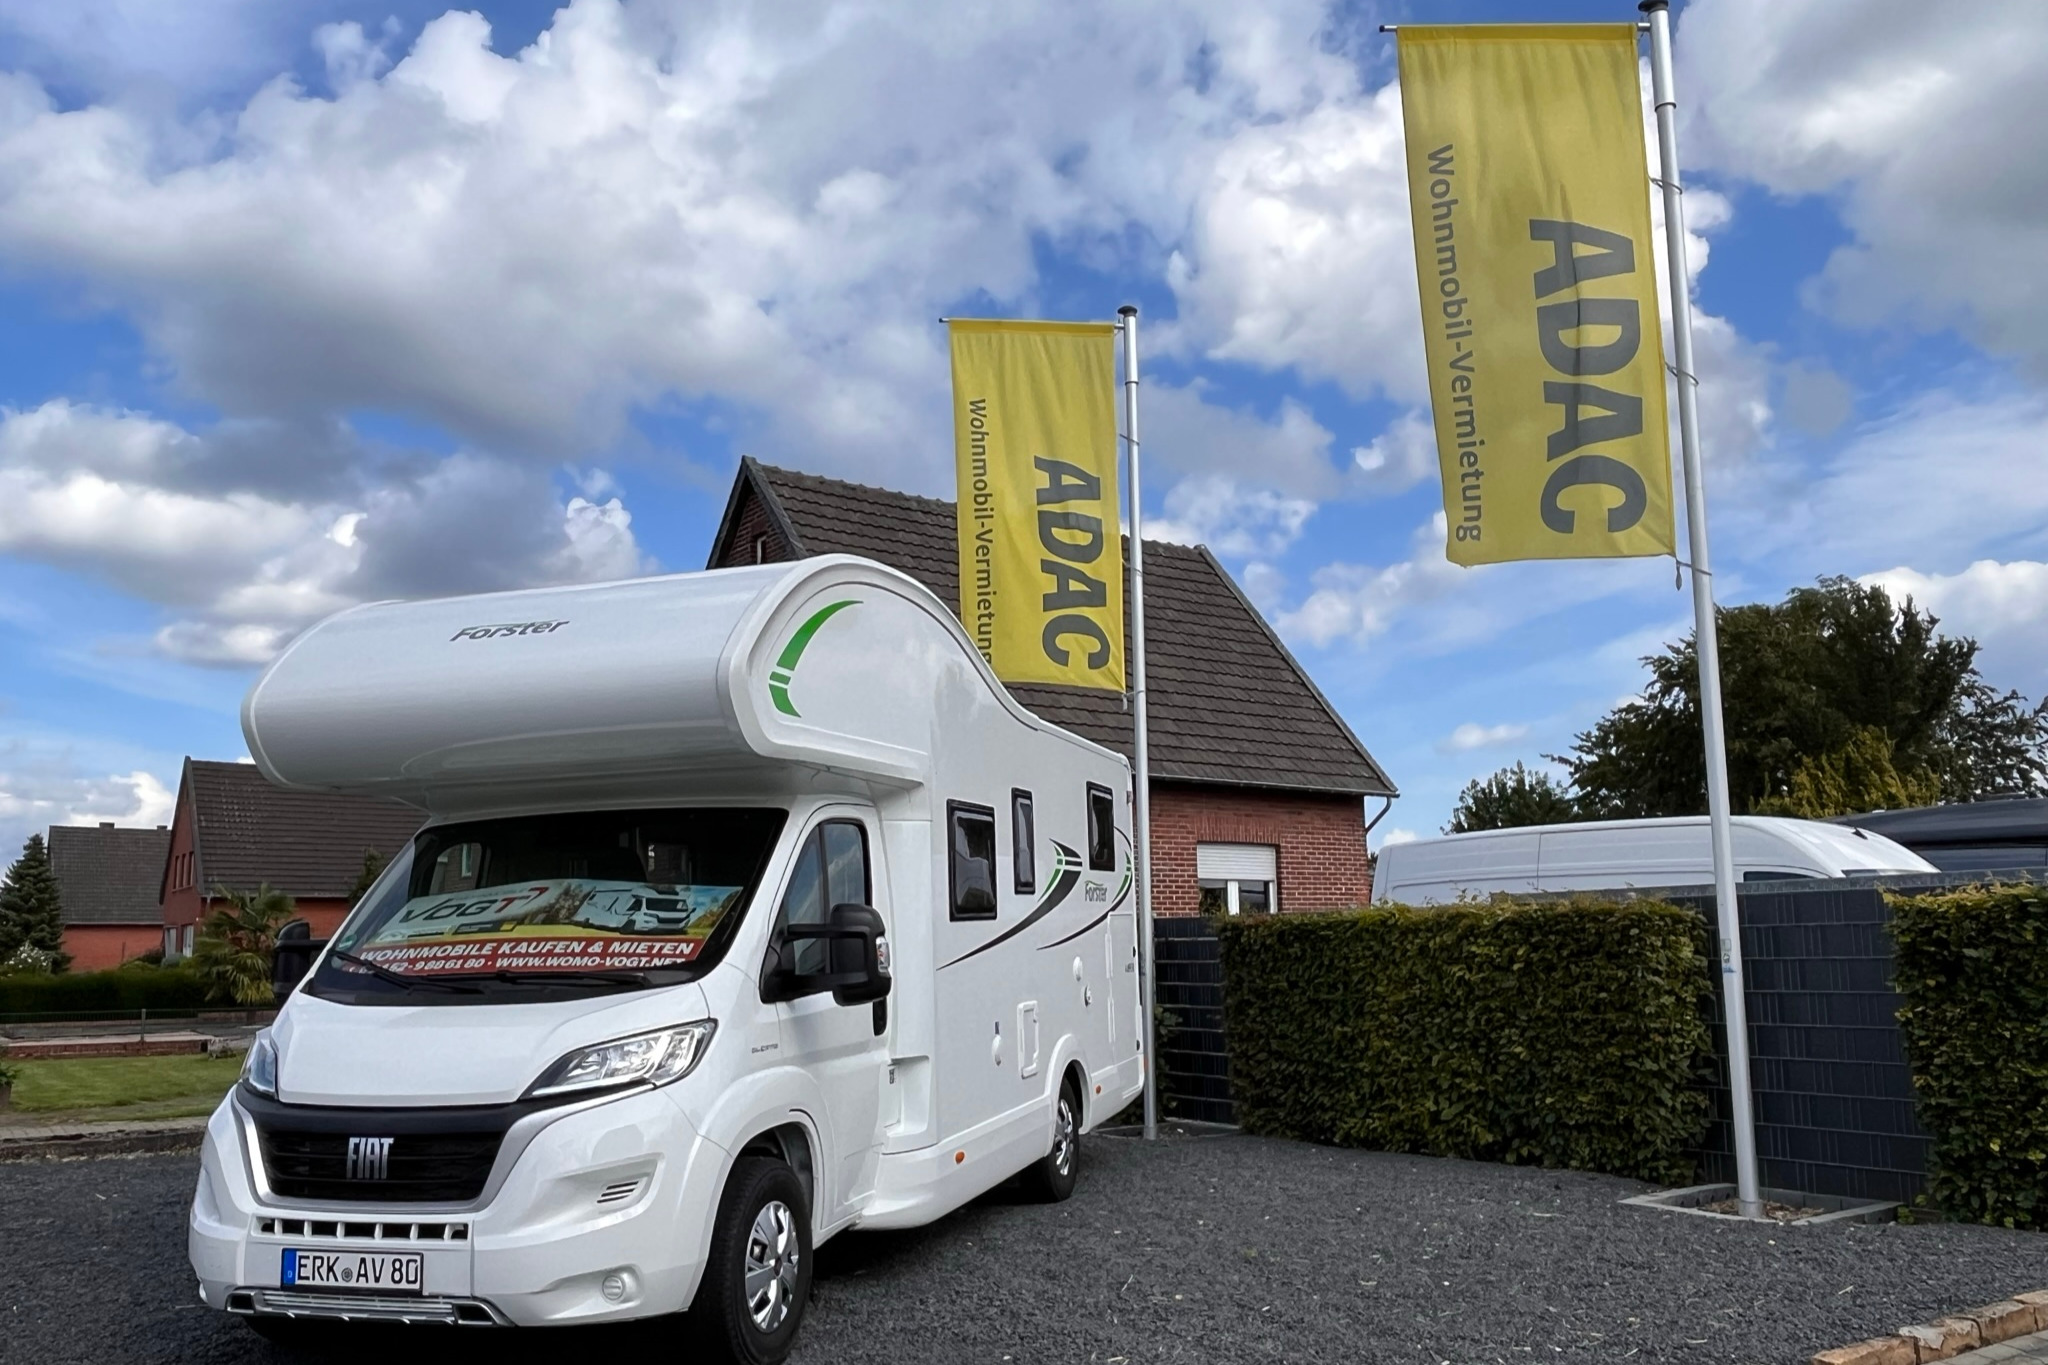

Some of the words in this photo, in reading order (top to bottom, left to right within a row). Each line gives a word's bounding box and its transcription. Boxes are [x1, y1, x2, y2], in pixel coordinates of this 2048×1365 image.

[1426, 143, 1486, 543] Wohnmobil-Vermietung
[1528, 217, 1647, 535] ADAC
[1033, 454, 1111, 670] ADAC
[449, 619, 570, 642] Forster
[1084, 882, 1108, 902] Forster
[398, 895, 533, 925] VOGT
[360, 942, 498, 961] WOHNMOBILE
[497, 941, 586, 955] KAUFEN
[587, 940, 604, 953] &
[612, 942, 695, 956] MIETEN
[346, 1136, 395, 1181] FIAT
[297, 1254, 340, 1283] ERK
[355, 1256, 385, 1284] AV
[390, 1257, 419, 1285] 80
